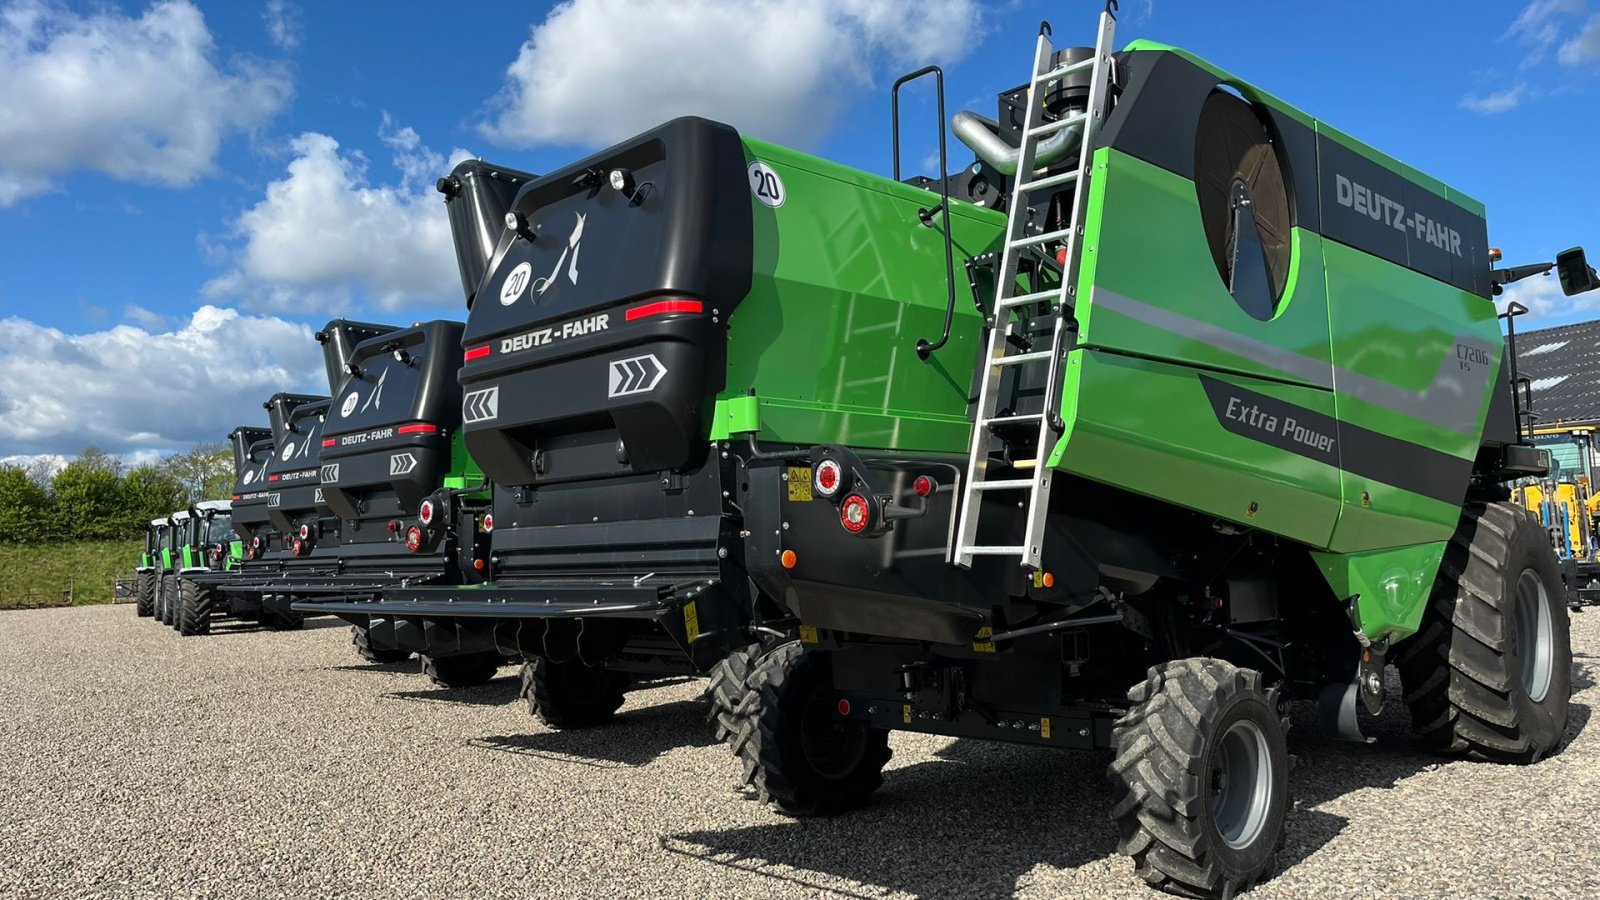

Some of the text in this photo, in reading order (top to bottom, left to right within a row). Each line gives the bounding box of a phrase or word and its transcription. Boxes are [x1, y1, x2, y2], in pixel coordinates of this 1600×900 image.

[754, 170, 779, 200] 20
[1336, 174, 1462, 257] DEUTZ-FAHR
[505, 271, 526, 298] 20
[500, 314, 609, 354] DEUTZ-FAHR
[1457, 344, 1488, 366] C7206
[342, 428, 393, 445] DEUTZ-FAHR
[1225, 396, 1335, 453] Extra Power
[282, 470, 317, 481] DEUTZ-FAHR
